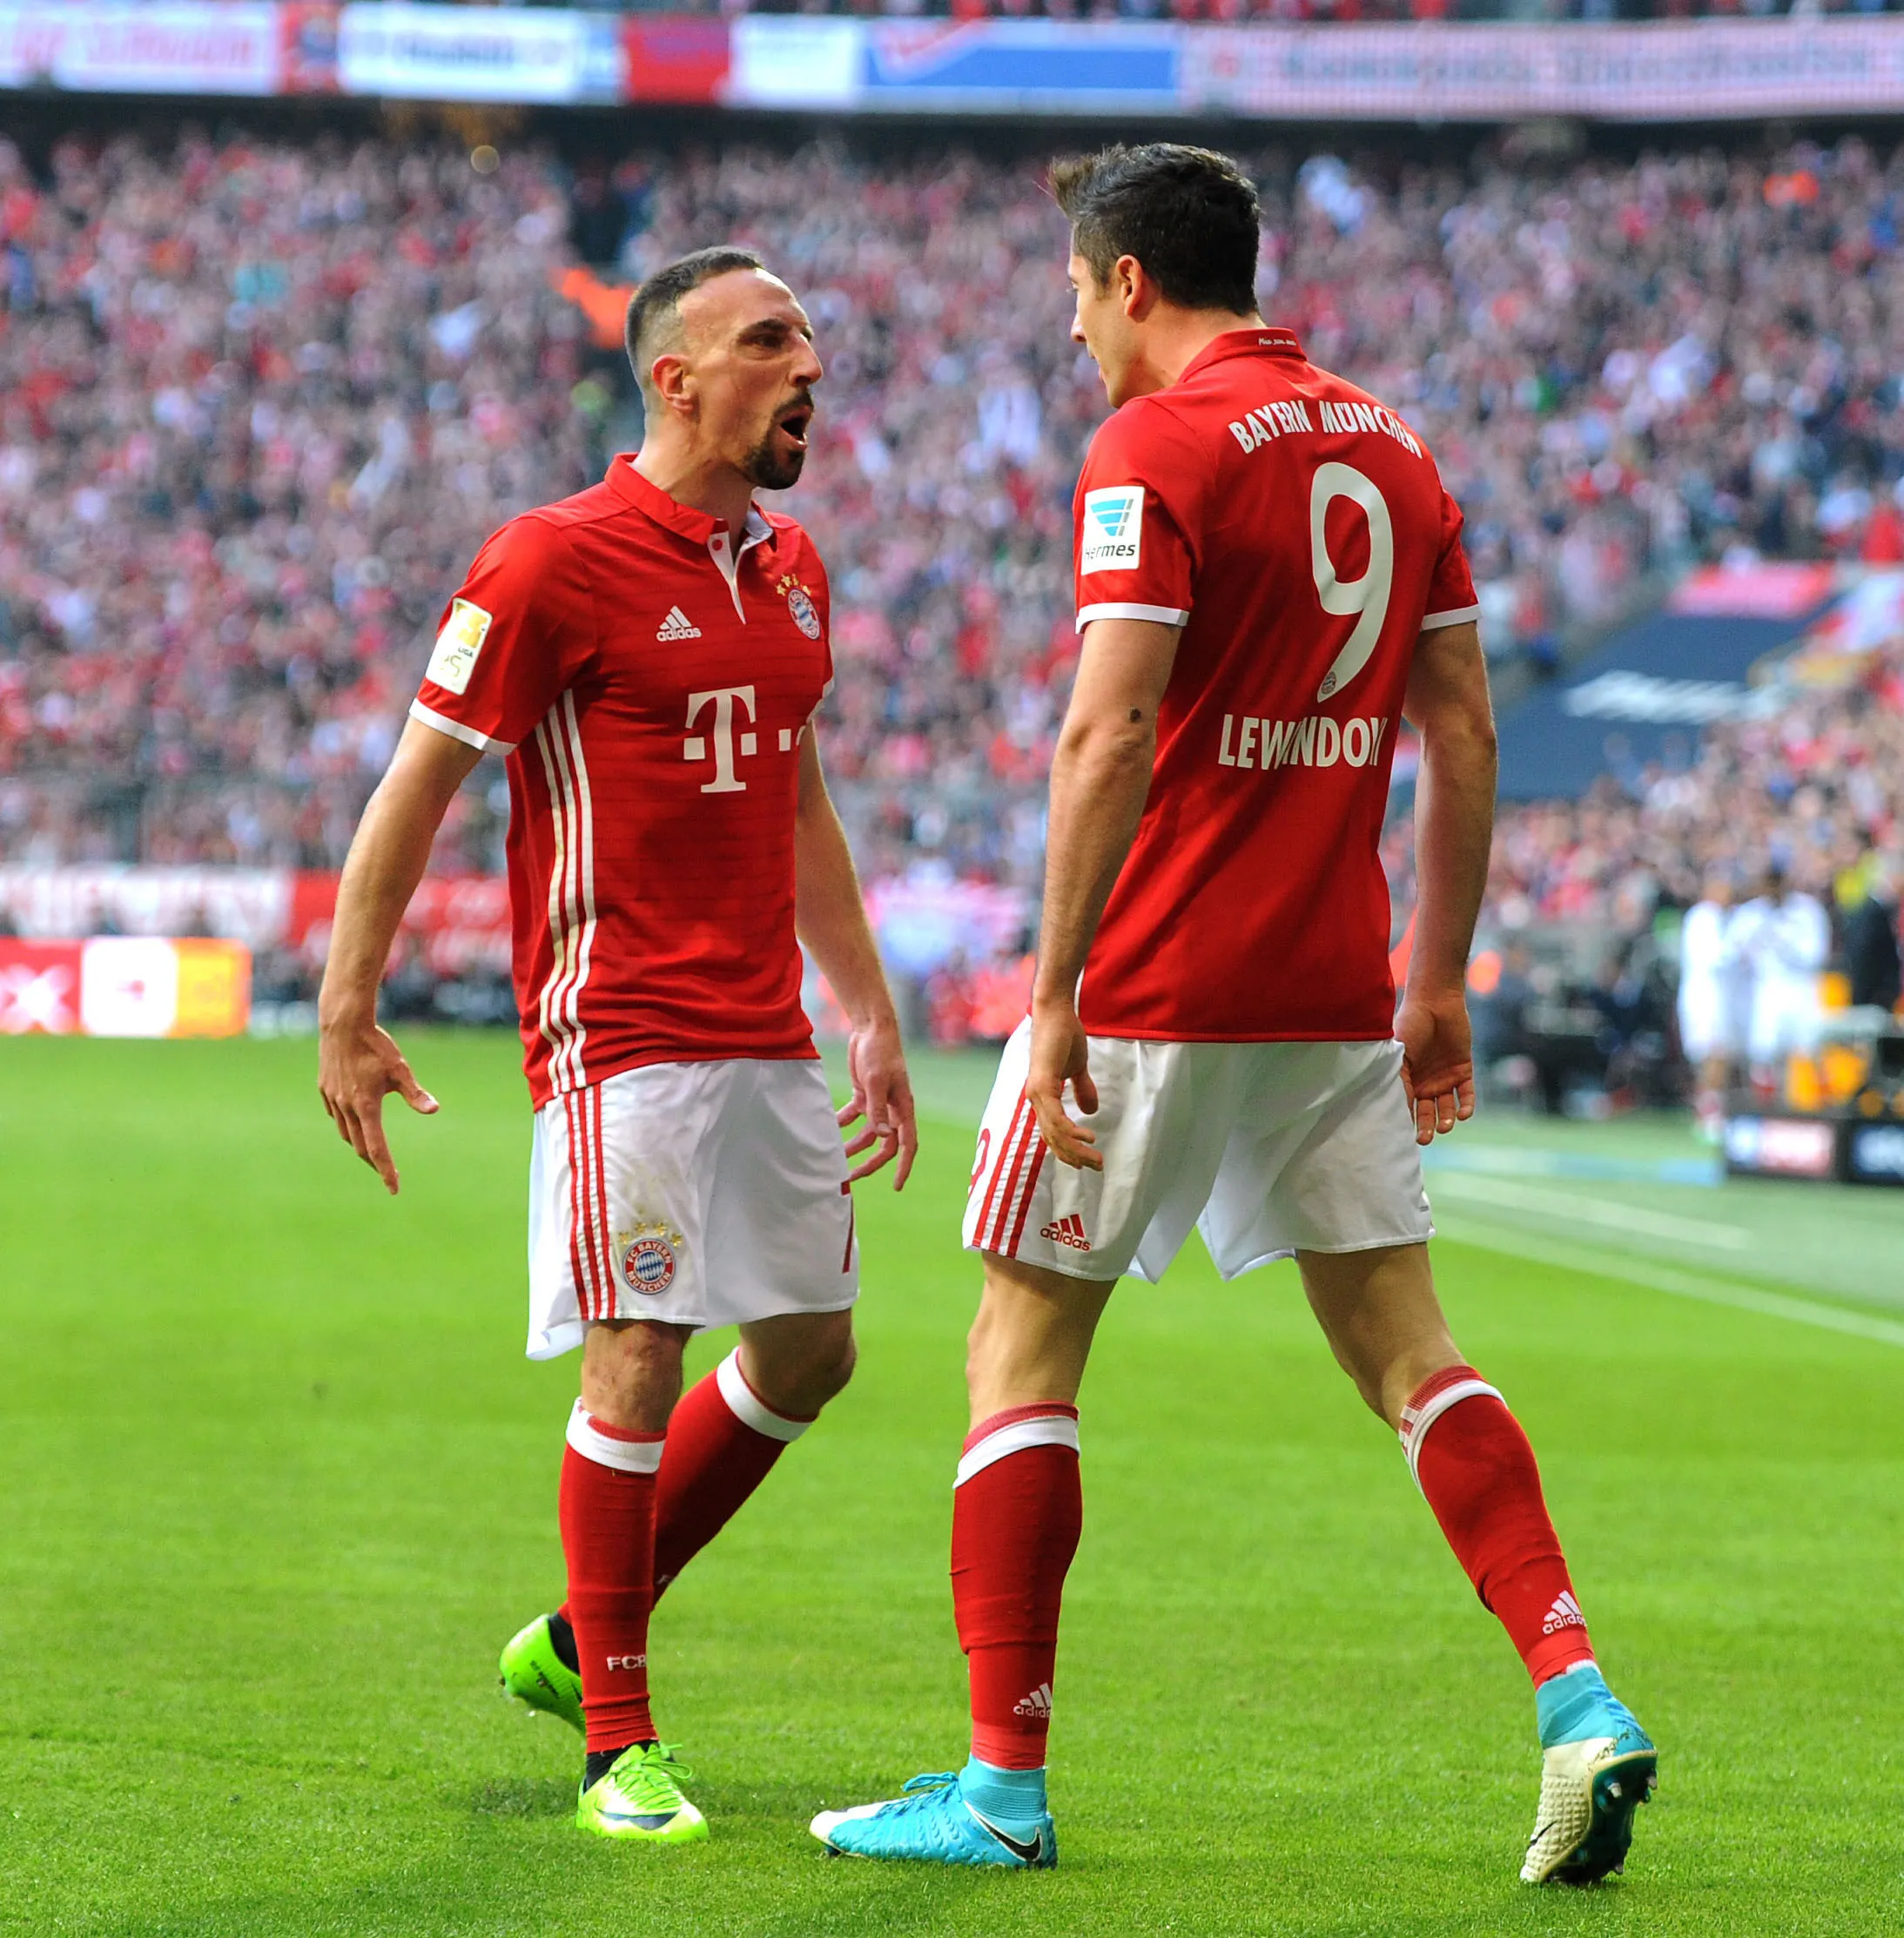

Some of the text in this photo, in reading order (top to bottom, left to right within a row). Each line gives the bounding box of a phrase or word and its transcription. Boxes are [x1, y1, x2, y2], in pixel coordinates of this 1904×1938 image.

[1228, 400, 1423, 459] BAYERN MÜNCHEN
[1310, 461, 1393, 703] 9
[656, 627, 702, 642] adidas
[1039, 1227, 1091, 1252] adidas
[1542, 1613, 1588, 1635] adida
